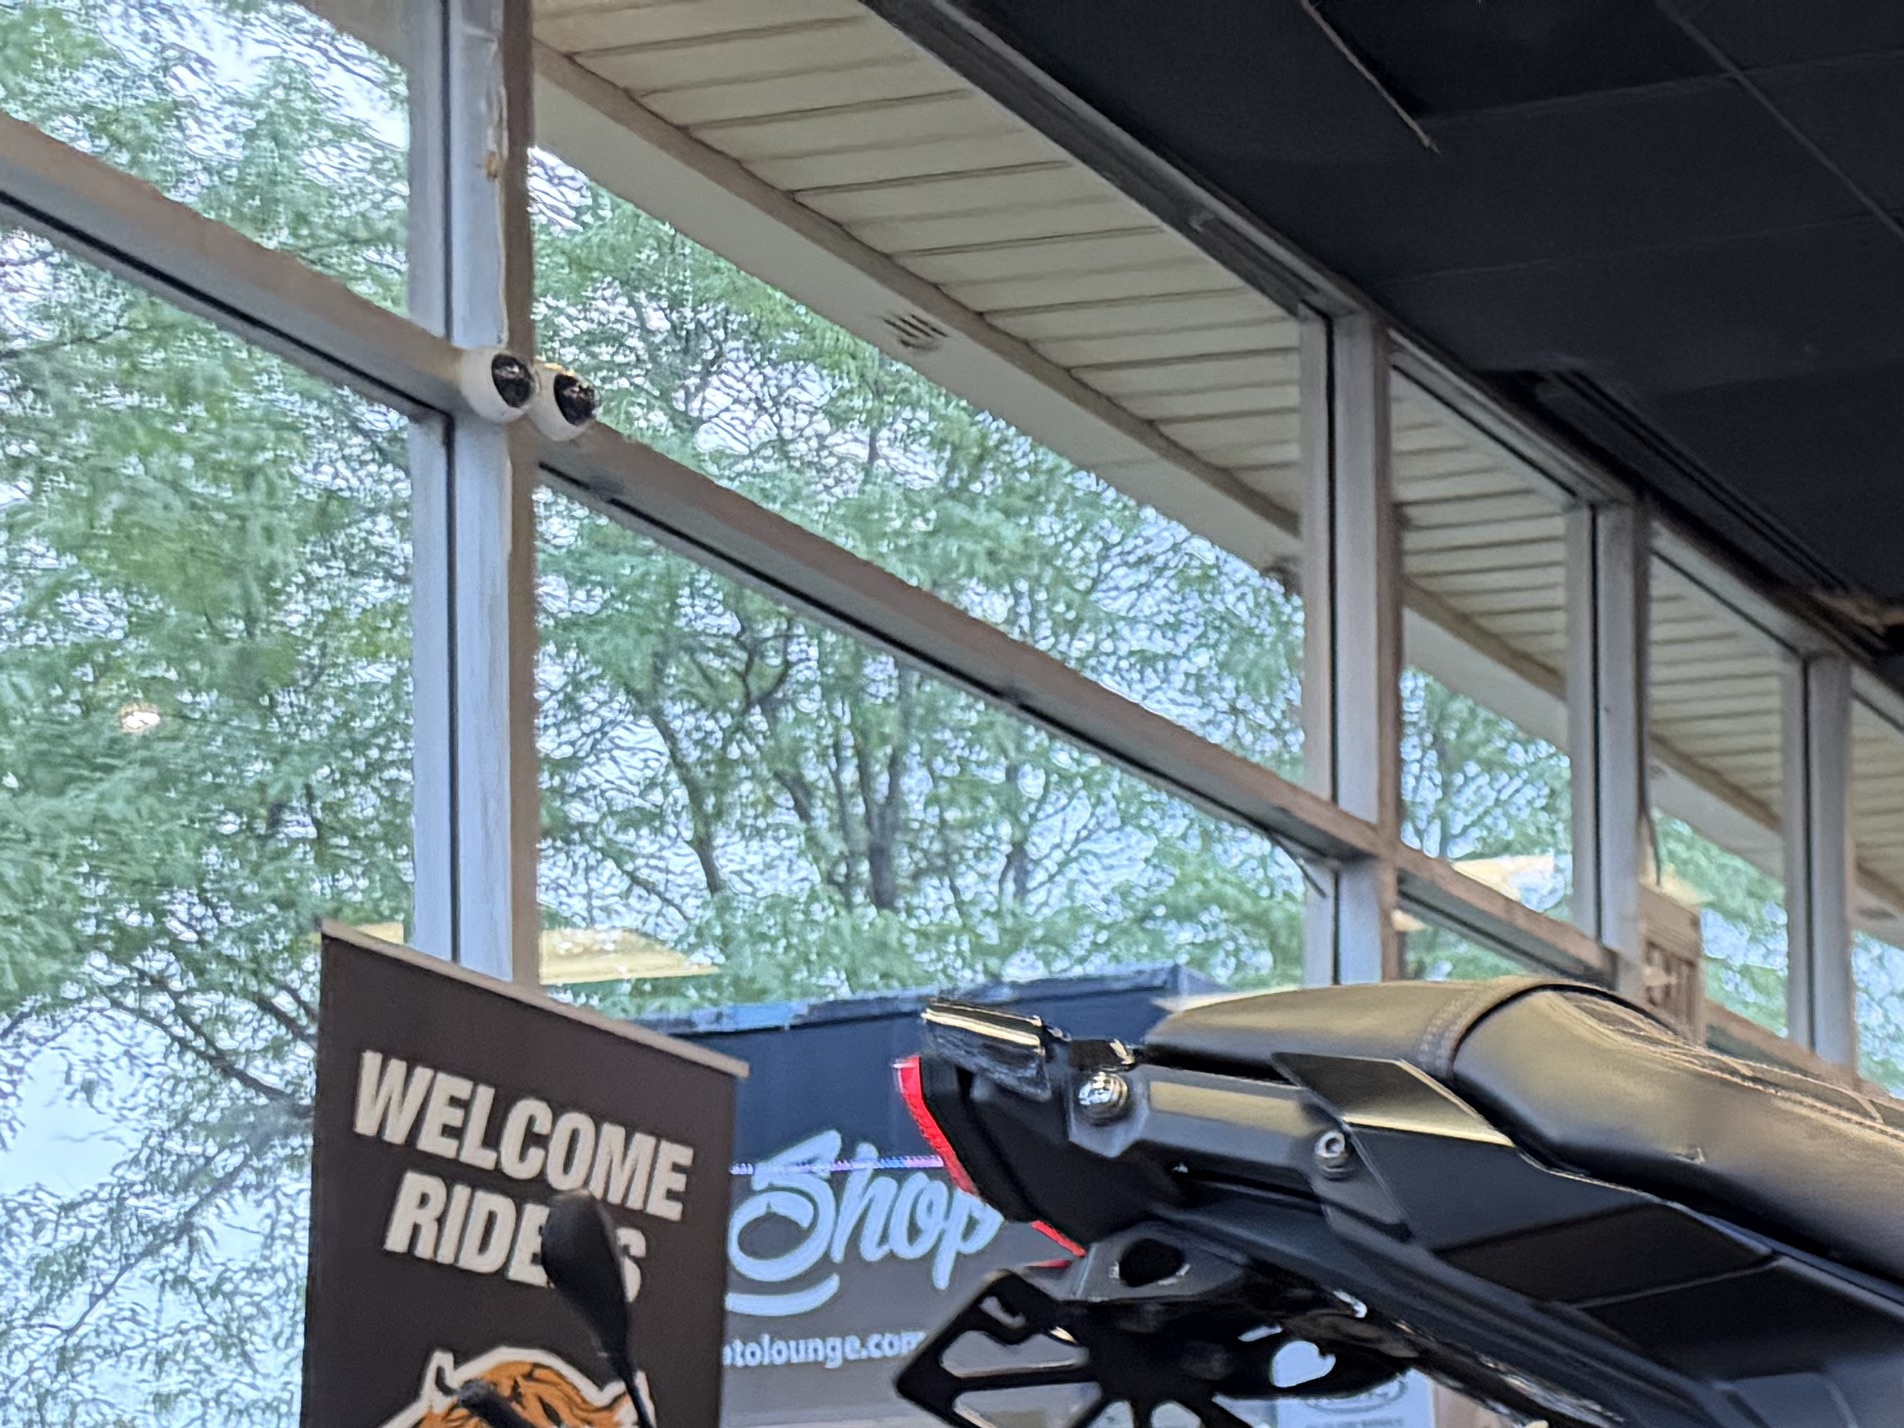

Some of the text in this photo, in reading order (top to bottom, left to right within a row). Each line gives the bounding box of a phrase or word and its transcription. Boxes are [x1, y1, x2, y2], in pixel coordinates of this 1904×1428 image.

[354, 1050, 695, 1222] WELCOME
[726, 1130, 1005, 1290] Shop
[383, 1170, 647, 1303] RIDES
